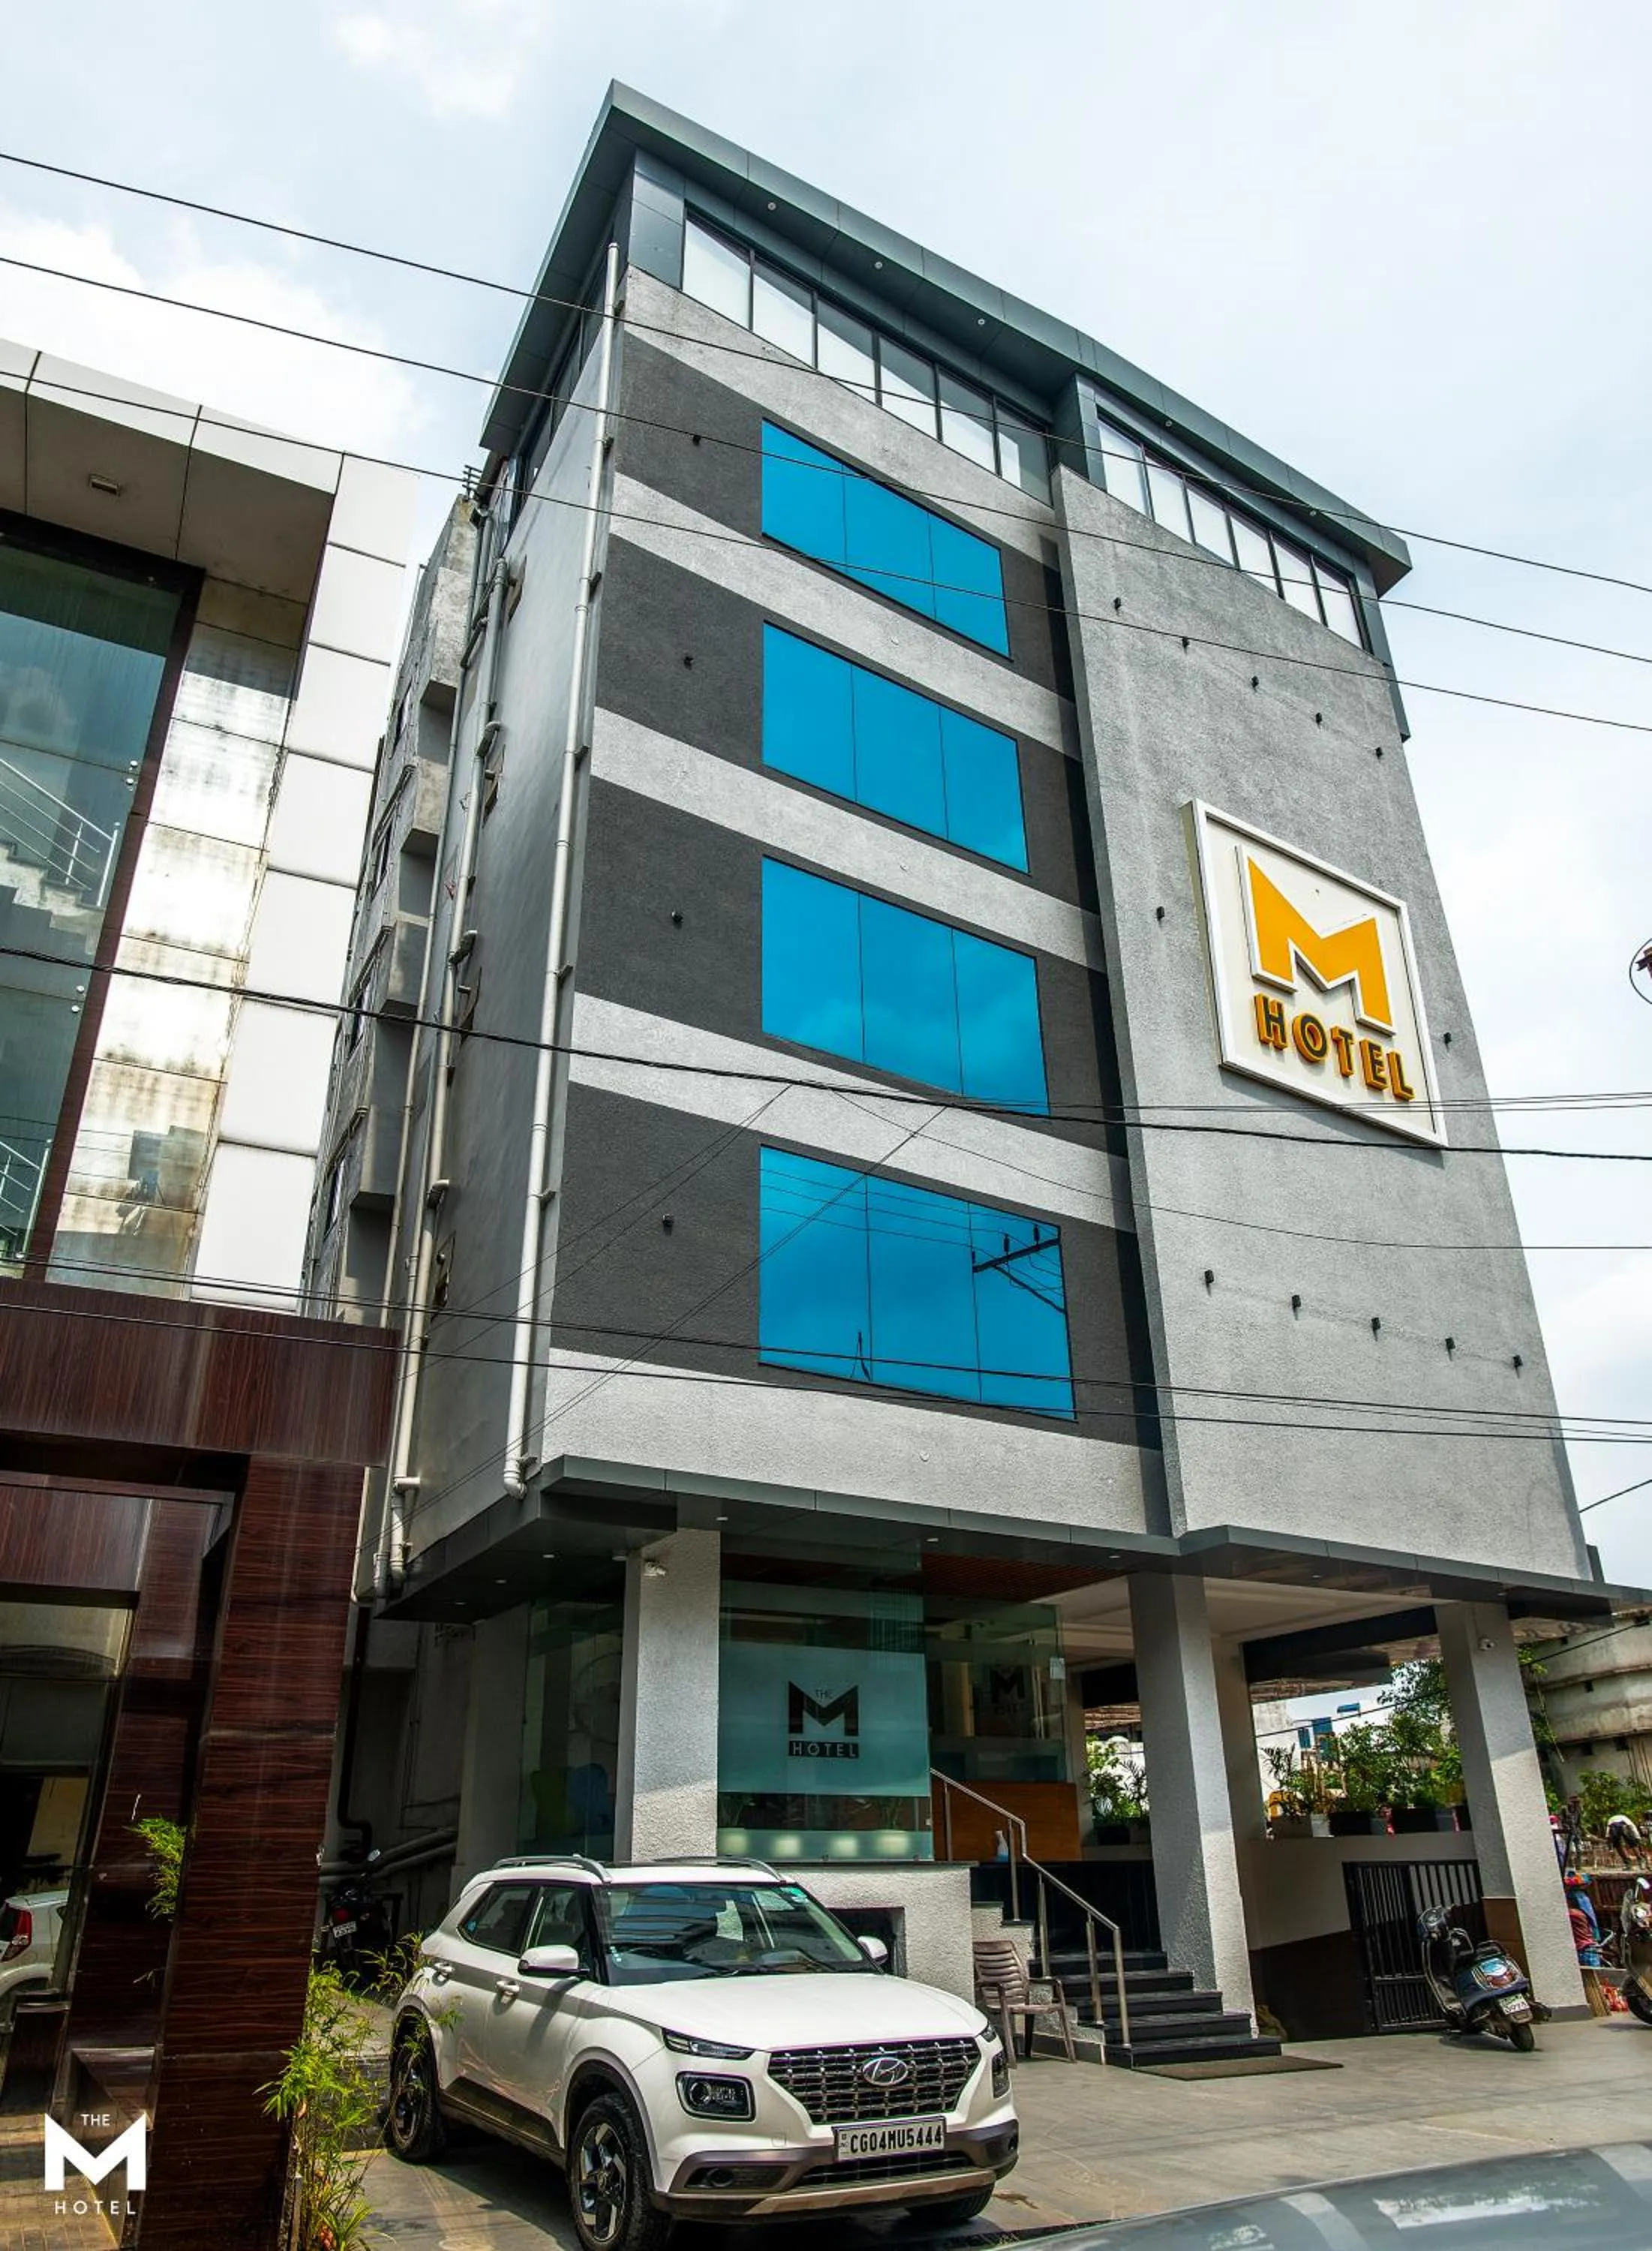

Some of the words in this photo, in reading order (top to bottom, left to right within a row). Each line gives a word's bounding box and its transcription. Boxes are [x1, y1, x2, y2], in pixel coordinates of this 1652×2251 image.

[1239, 848, 1395, 1033] M
[1254, 993, 1415, 1101] HOTEL
[788, 1680, 859, 1736] M
[791, 1742, 856, 1757] HOTEL
[850, 2124, 942, 2153] CG04MU5444
